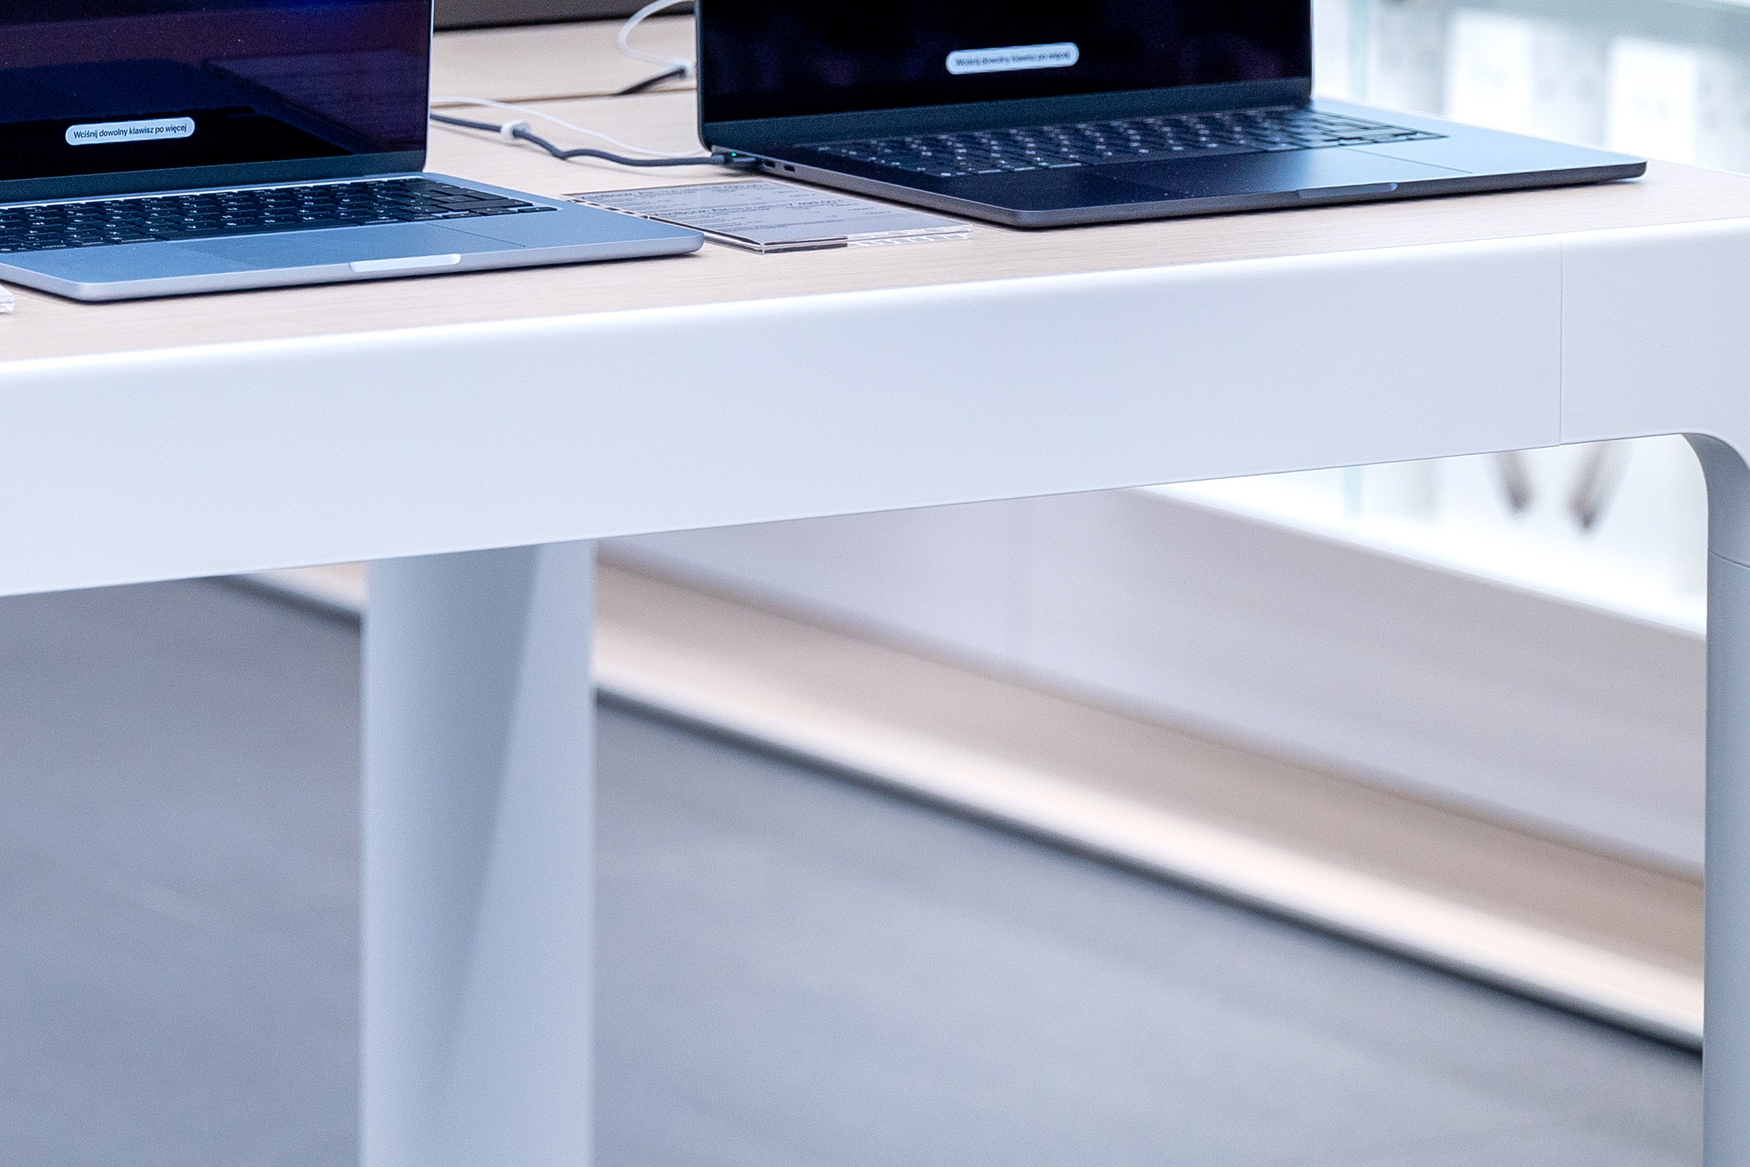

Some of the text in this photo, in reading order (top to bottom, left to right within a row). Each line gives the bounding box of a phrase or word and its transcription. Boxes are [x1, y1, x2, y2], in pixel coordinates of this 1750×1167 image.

[73, 123, 187, 139] Wciśnij dowolny klawisz po więcej
